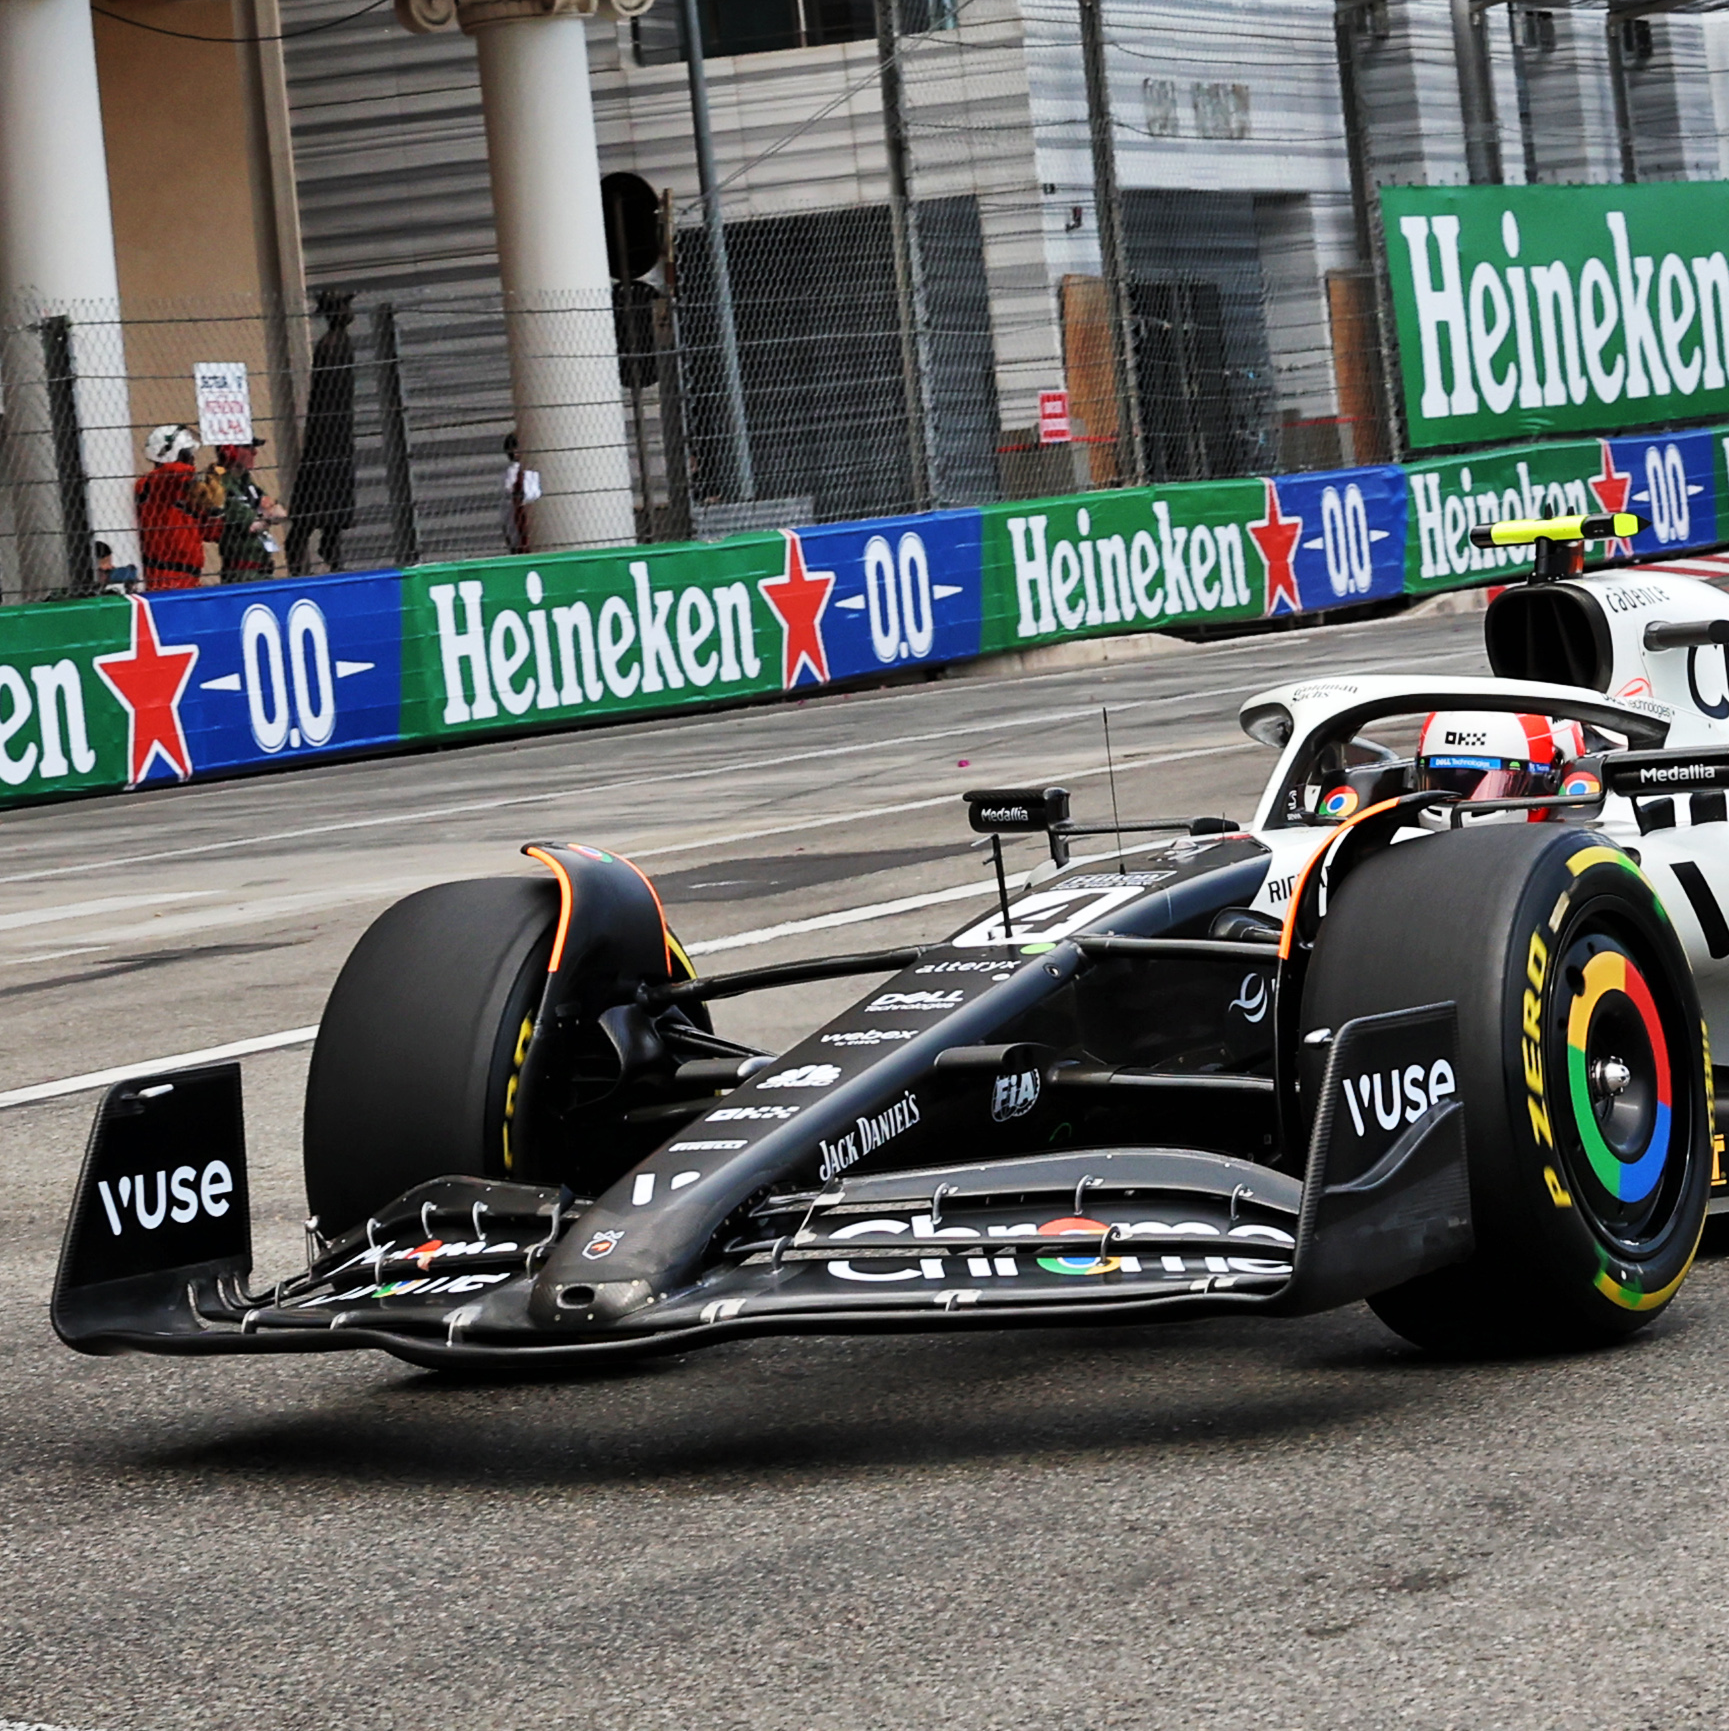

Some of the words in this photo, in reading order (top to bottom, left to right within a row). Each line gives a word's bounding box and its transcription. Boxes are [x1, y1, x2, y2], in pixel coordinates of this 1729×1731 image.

[1007, 506, 1249, 639] Heineken
[1320, 482, 1371, 597] 0.0
[429, 561, 762, 724] Heineken
[867, 531, 934, 664] 0.0
[241, 598, 336, 754] 0.0
[1444, 731, 1486, 746] OKX
[1640, 764, 1715, 783] Medallia
[981, 807, 1028, 821] Medallia
[915, 958, 1021, 974] alteryx
[871, 990, 965, 1005] DELL
[864, 1001, 956, 1012] Technologies
[821, 1030, 919, 1042] webex
[1522, 925, 1554, 1150] ZERO
[819, 1130, 860, 1181] JACK
[856, 1090, 921, 1155] DANIEL'S
